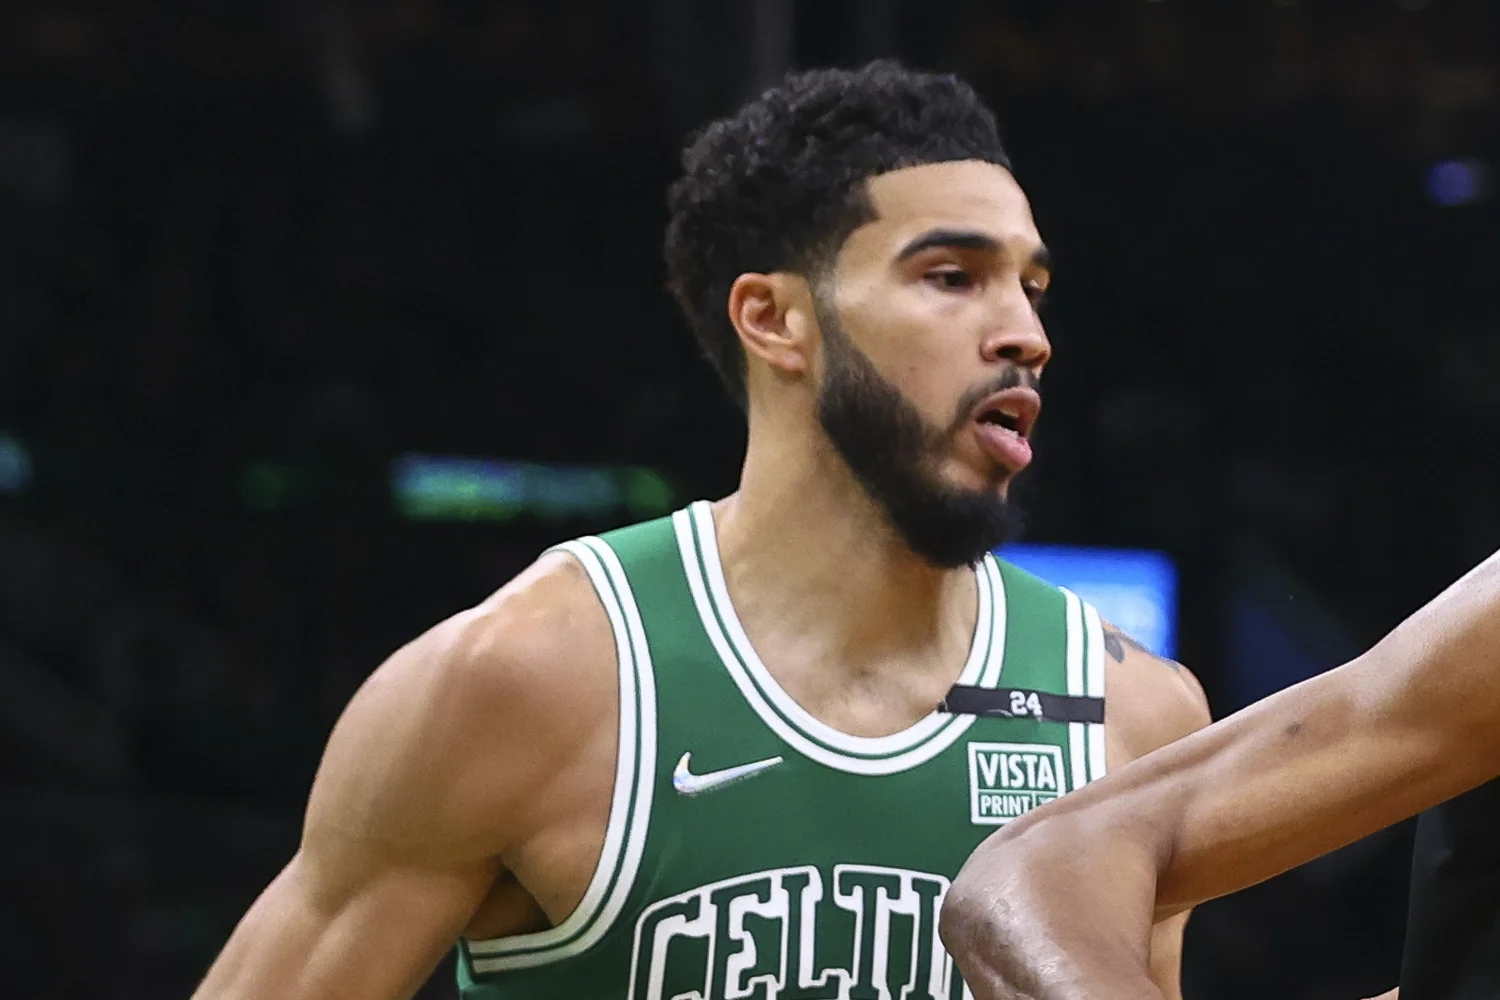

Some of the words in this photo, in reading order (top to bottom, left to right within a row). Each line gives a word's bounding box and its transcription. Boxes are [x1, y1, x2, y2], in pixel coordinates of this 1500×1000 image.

[1009, 690, 1044, 717] 24
[977, 752, 1058, 790] VISTA
[980, 794, 1031, 816] PRINT
